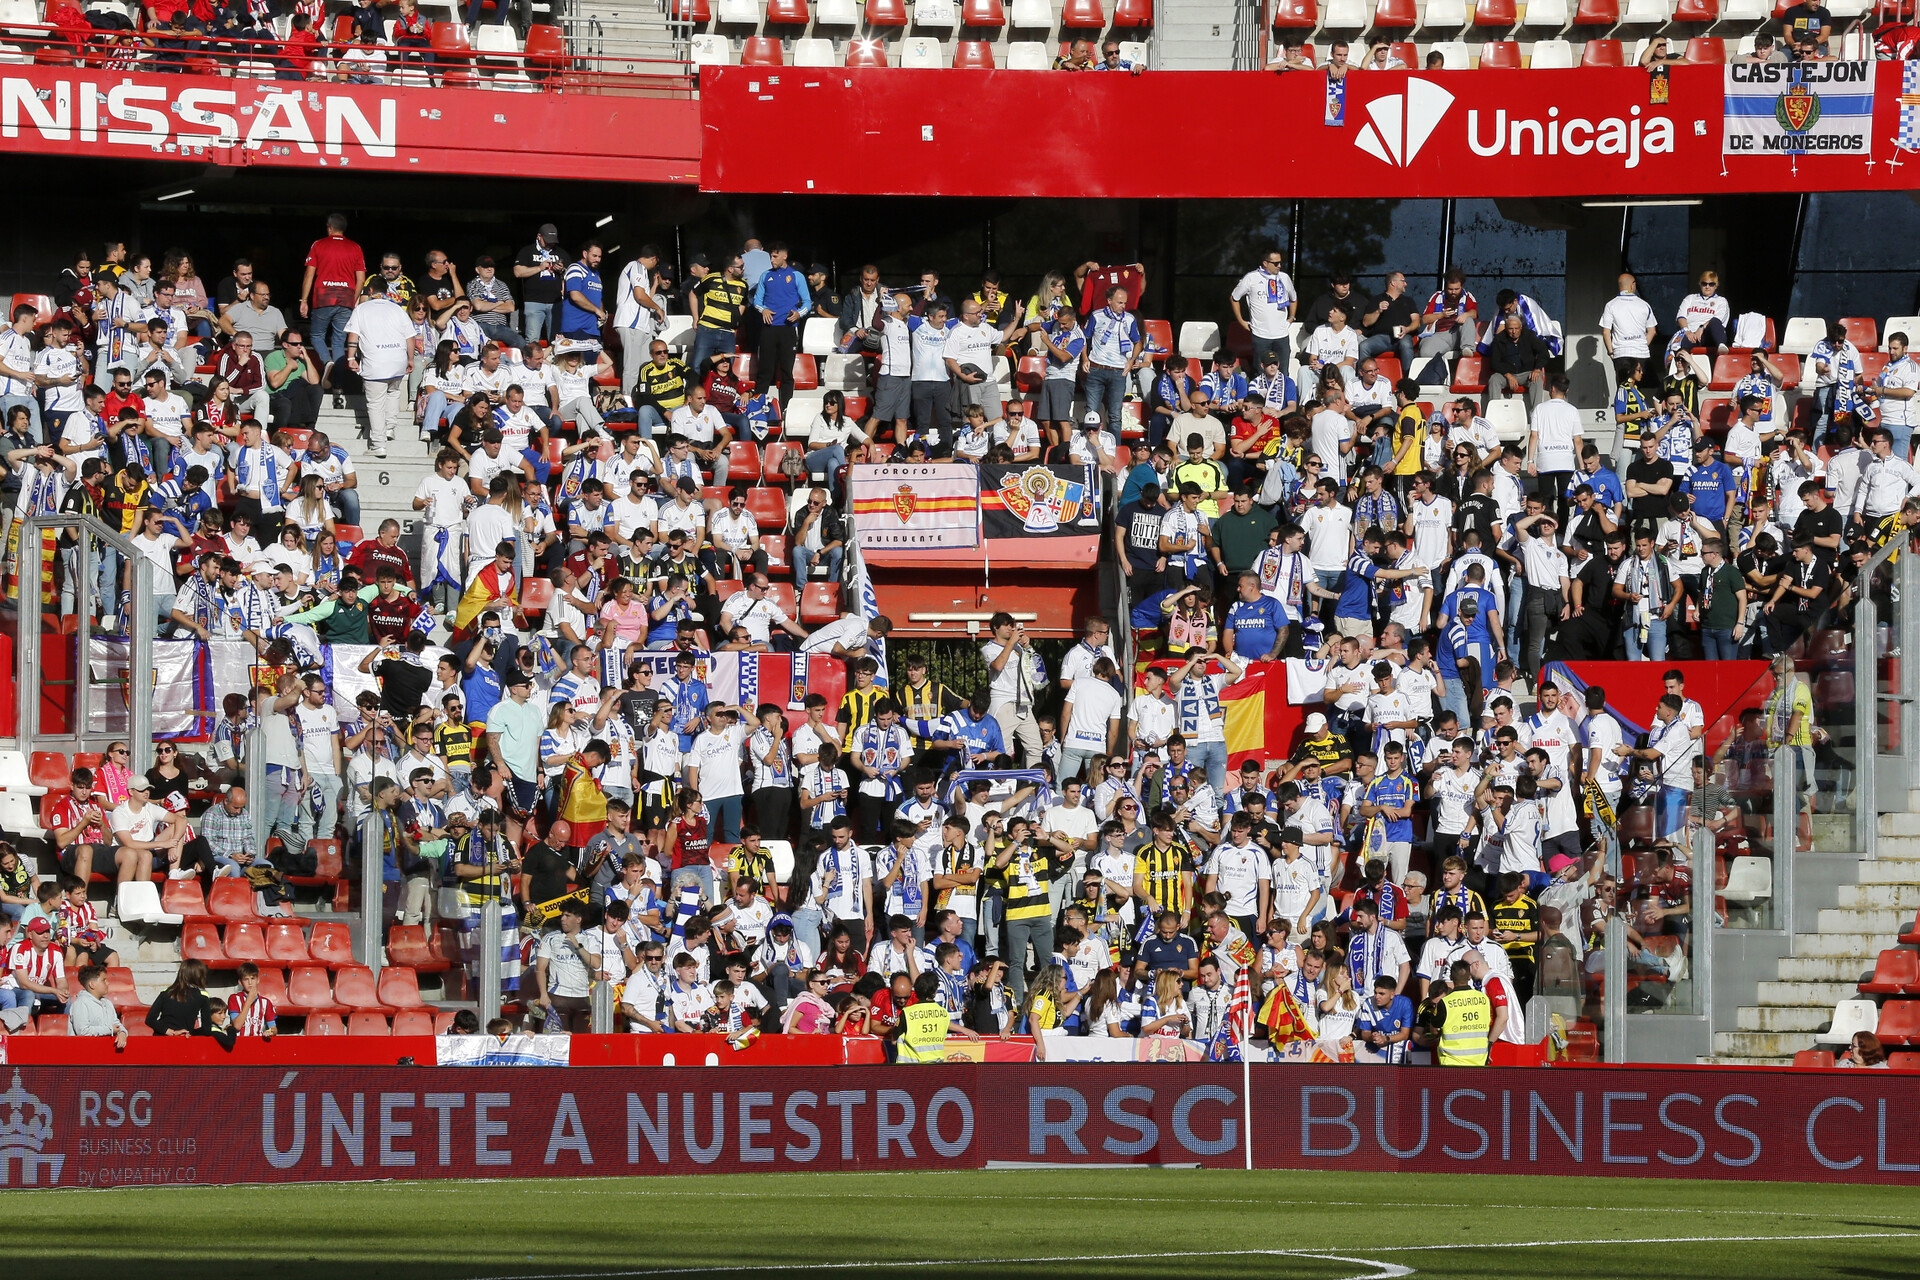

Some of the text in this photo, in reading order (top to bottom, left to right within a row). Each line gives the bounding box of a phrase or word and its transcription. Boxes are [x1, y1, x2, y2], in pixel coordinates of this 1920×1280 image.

[1731, 61, 1868, 83] CASTEJON
[2, 77, 397, 158] NISSAN
[1467, 105, 1675, 169] Unicaja
[1730, 134, 1863, 150] DE MONEGROS
[1595, 410, 1607, 423] 8
[379, 472, 390, 486] 6
[403, 521, 413, 534] 5
[1449, 996, 1487, 1009] SEGURIDAD
[909, 1010, 948, 1021] SEGURIDAD
[1462, 1011, 1479, 1023] 506
[921, 1023, 938, 1034] 531
[80, 1090, 153, 1127] RSG
[262, 1072, 512, 1168] ÚNETE
[543, 1092, 594, 1165] A
[626, 1087, 974, 1164] NUESTRO
[1028, 1085, 1238, 1155] RSG
[1301, 1085, 1761, 1168] BUSINESS
[79, 1138, 197, 1156] BUSINESS CLUB
[79, 1167, 96, 1187] by
